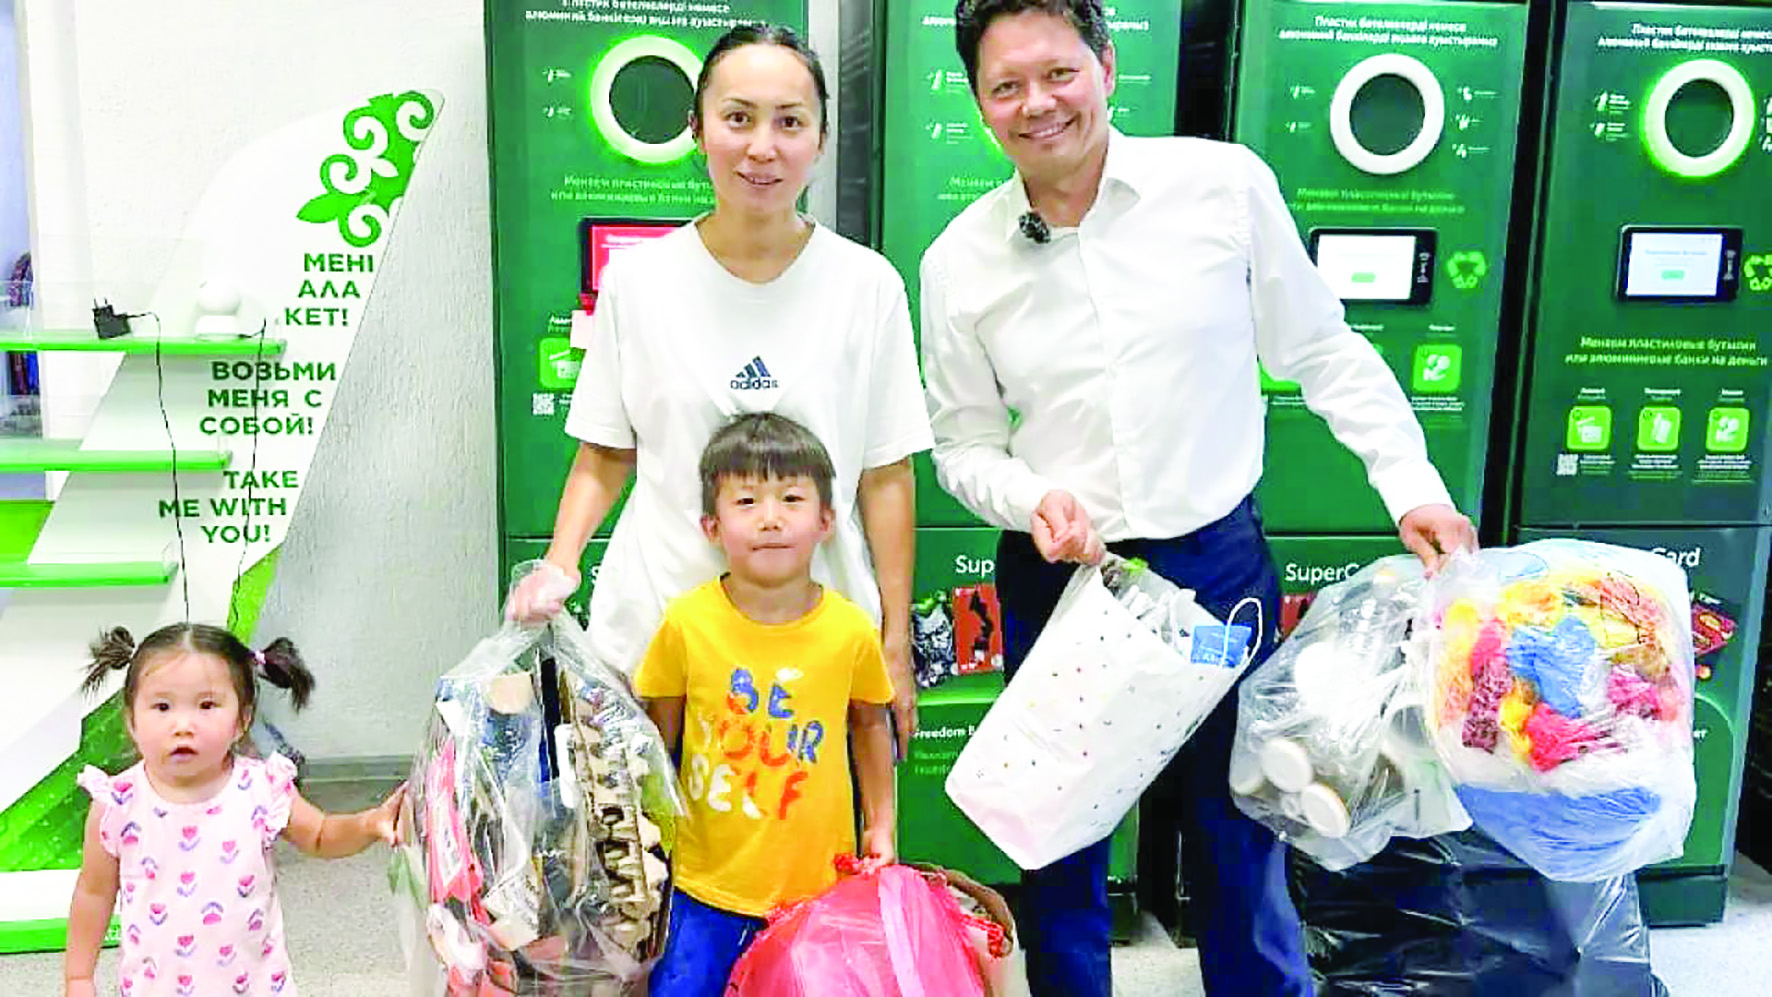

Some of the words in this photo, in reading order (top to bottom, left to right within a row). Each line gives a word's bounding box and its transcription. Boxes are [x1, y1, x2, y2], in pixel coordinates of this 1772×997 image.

[303, 253, 374, 272] МЕНІ
[297, 279, 360, 299] АЛА
[284, 307, 349, 326] КЕТ!
[211, 361, 337, 381] ВОЗЬМИ
[207, 389, 289, 408] МЕНЯ
[304, 389, 322, 408] С
[199, 412, 314, 435] СОБОЙ!
[223, 470, 299, 489] TAKE
[158, 499, 200, 518] ME
[210, 498, 287, 517] WITH
[200, 525, 271, 543] YOU!
[955, 555, 995, 577] Sup
[1285, 563, 1359, 584] SuperC
[726, 667, 804, 718] BE
[688, 751, 808, 820] SELF
